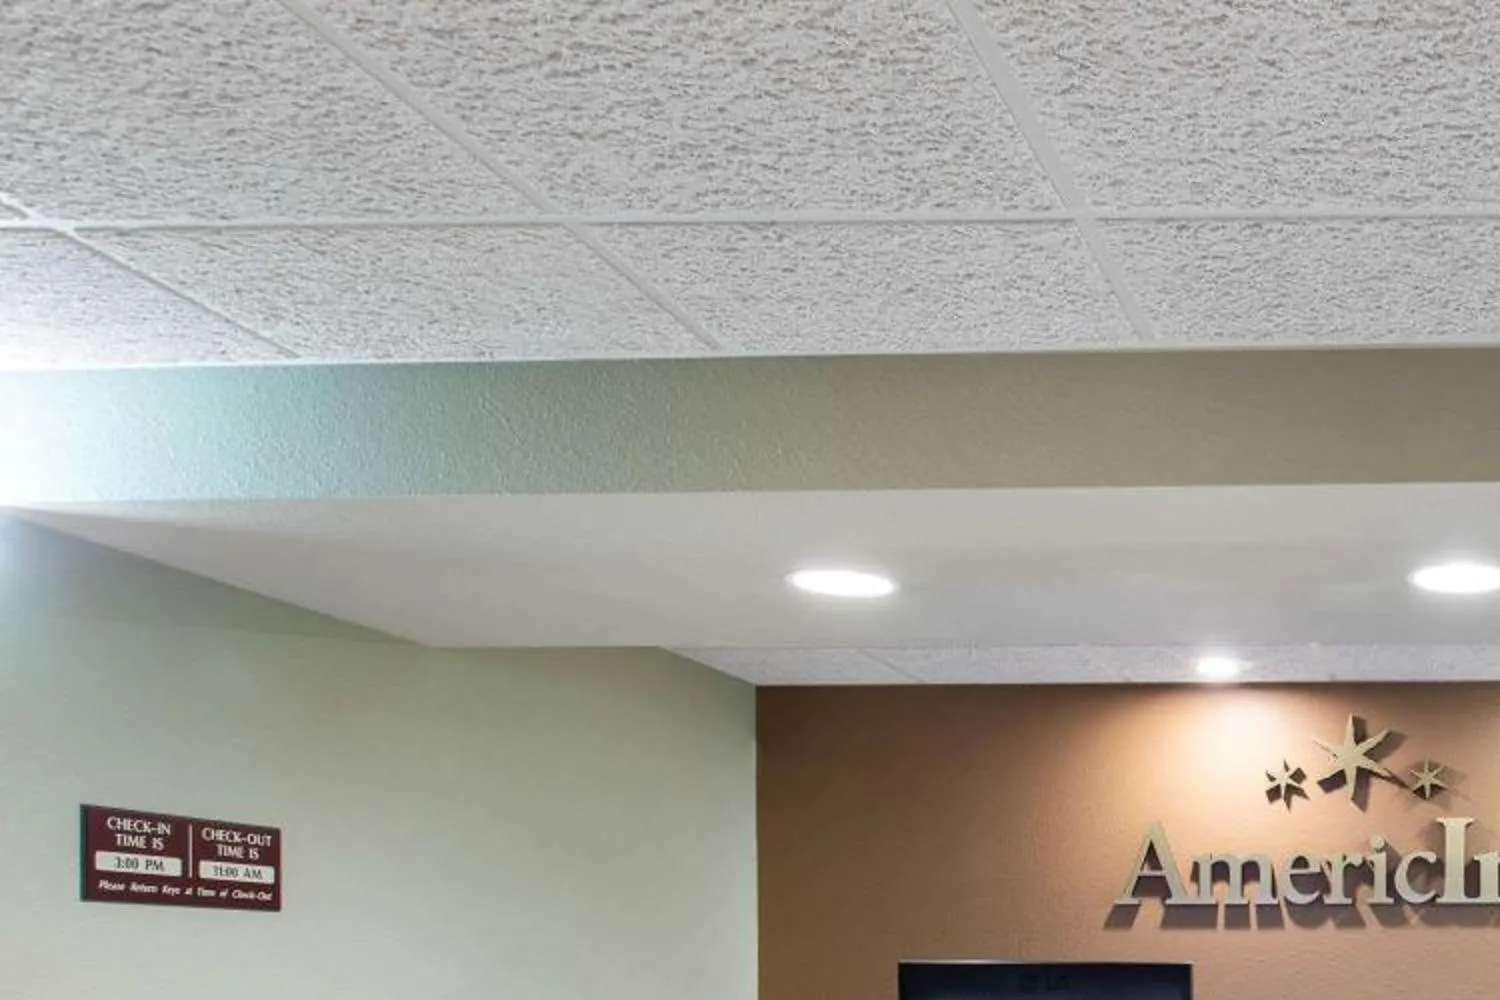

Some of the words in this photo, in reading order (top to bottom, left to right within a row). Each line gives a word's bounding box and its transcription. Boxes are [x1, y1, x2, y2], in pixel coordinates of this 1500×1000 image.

[107, 816, 171, 835] CHECK-IN
[115, 833, 147, 849] TIME
[152, 837, 164, 850] IS
[201, 827, 272, 847] CHECK-OUT
[215, 843, 245, 859] TIME
[249, 847, 260, 860] IS
[114, 856, 139, 869] 3:00
[144, 859, 165, 872] PM
[213, 865, 238, 878] 11:00
[243, 867, 263, 880] AM
